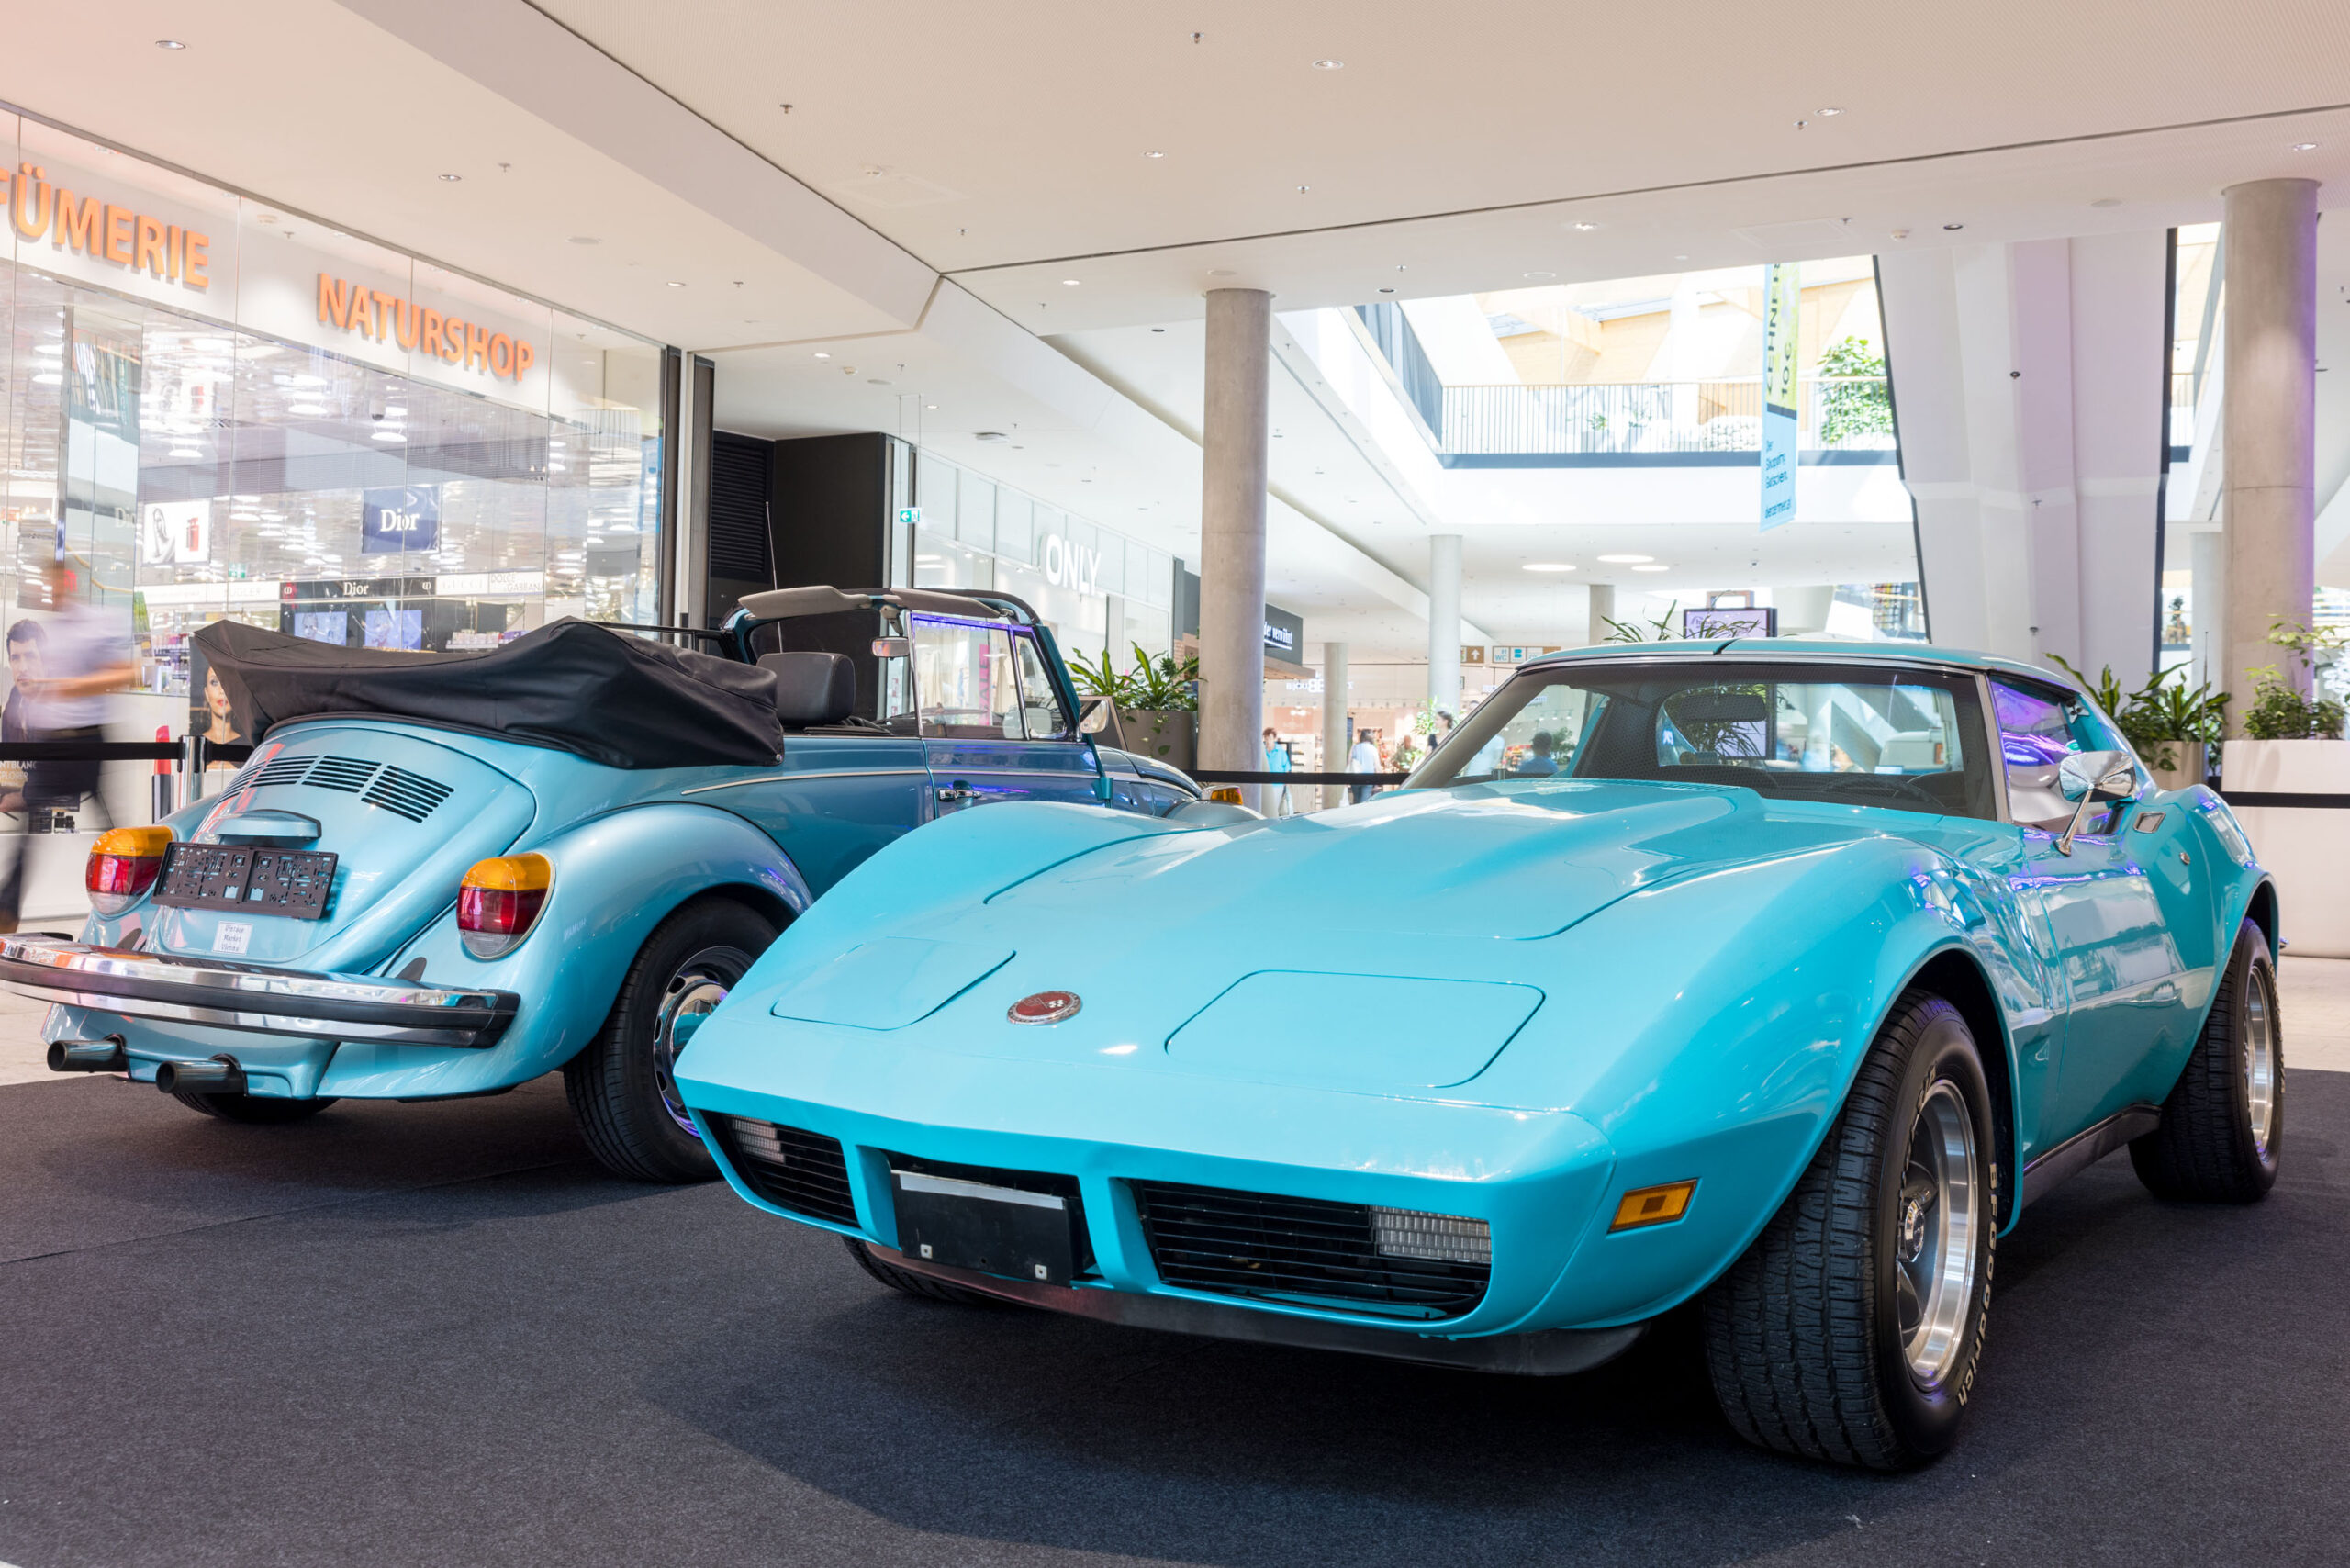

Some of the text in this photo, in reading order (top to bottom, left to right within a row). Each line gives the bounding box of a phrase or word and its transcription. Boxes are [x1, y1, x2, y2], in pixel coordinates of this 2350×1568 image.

[318, 272, 535, 382] NATURSHOP
[379, 509, 420, 532] Dior
[1045, 533, 1102, 596] ONLY
[343, 581, 369, 596] Dior
[490, 573, 516, 583] DOLCE
[1494, 654, 1507, 662] WC
[1957, 1162, 1998, 1406] BFGoodrich
